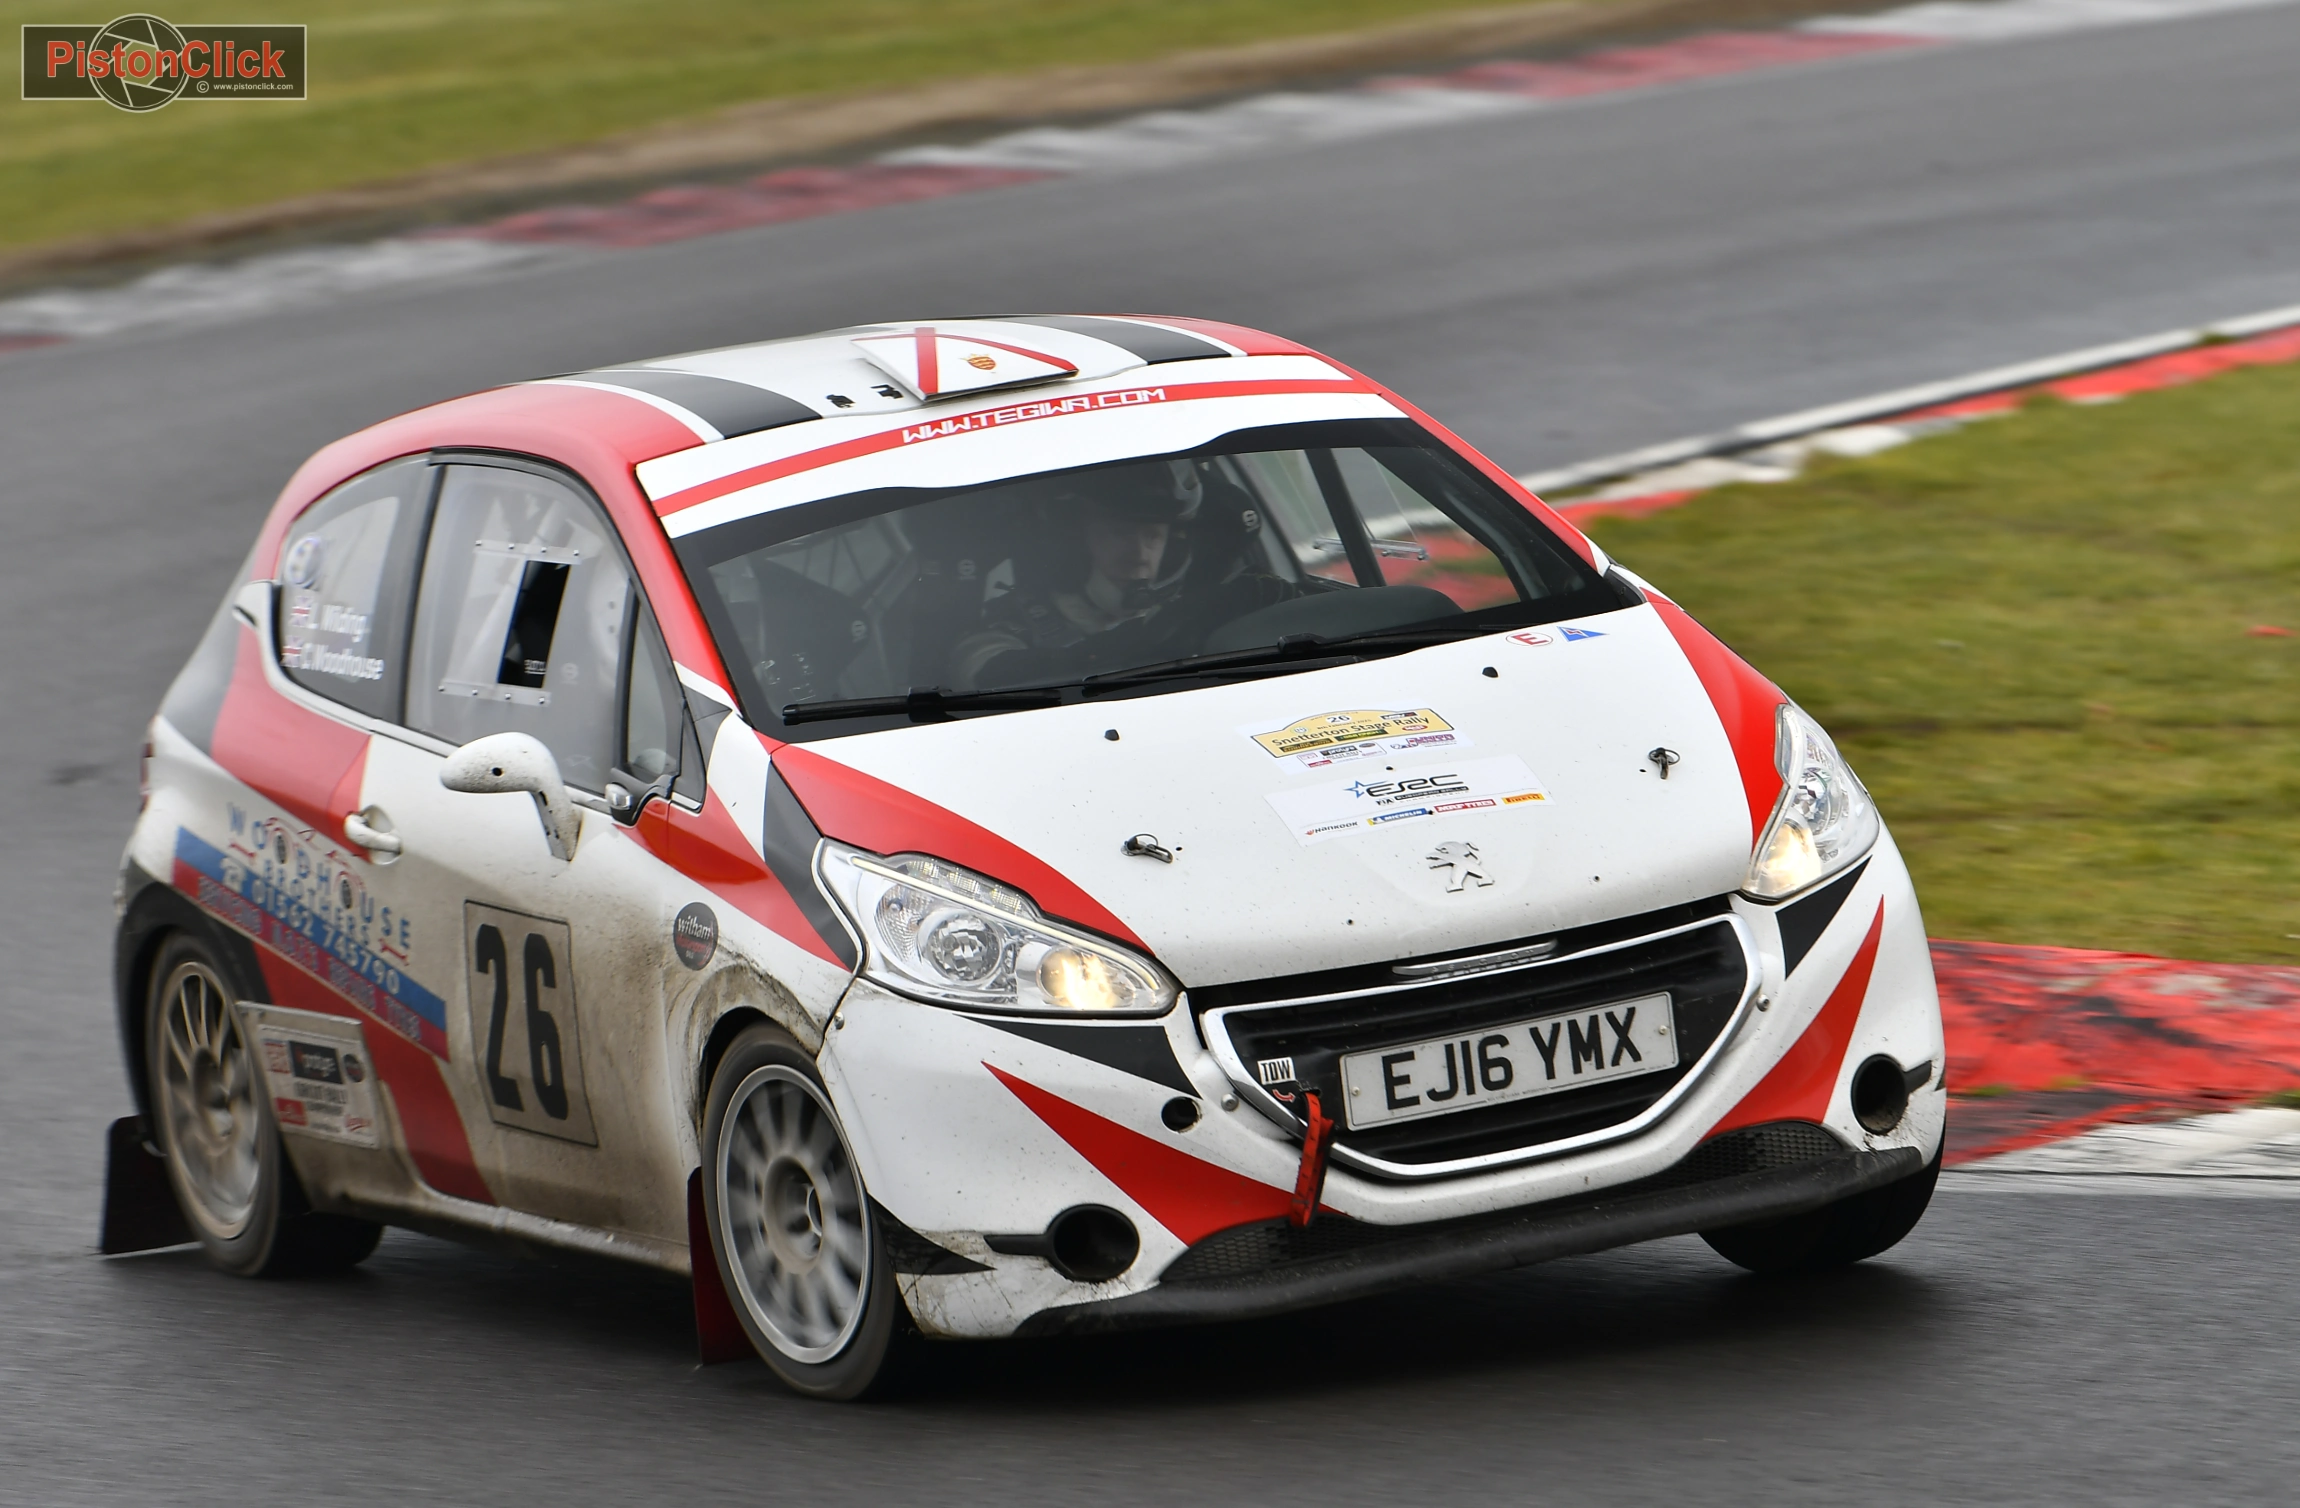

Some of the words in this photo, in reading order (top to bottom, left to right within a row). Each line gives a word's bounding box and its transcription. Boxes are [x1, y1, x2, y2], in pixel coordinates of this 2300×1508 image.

[902, 388, 1166, 443] WWW.TEGIWA.COM
[1511, 632, 1549, 645] E
[1272, 725, 1350, 746] Snetterton
[1351, 720, 1391, 732] Stage
[1393, 716, 1429, 726] Rally
[1327, 714, 1350, 723] 26
[1384, 810, 1423, 820] MICHELIN
[1506, 794, 1540, 803] PIRELLI
[475, 923, 569, 1121] 26
[1260, 1059, 1291, 1082] TOW
[1381, 1033, 1514, 1111] EJ16
[1529, 1006, 1643, 1080] YMX
